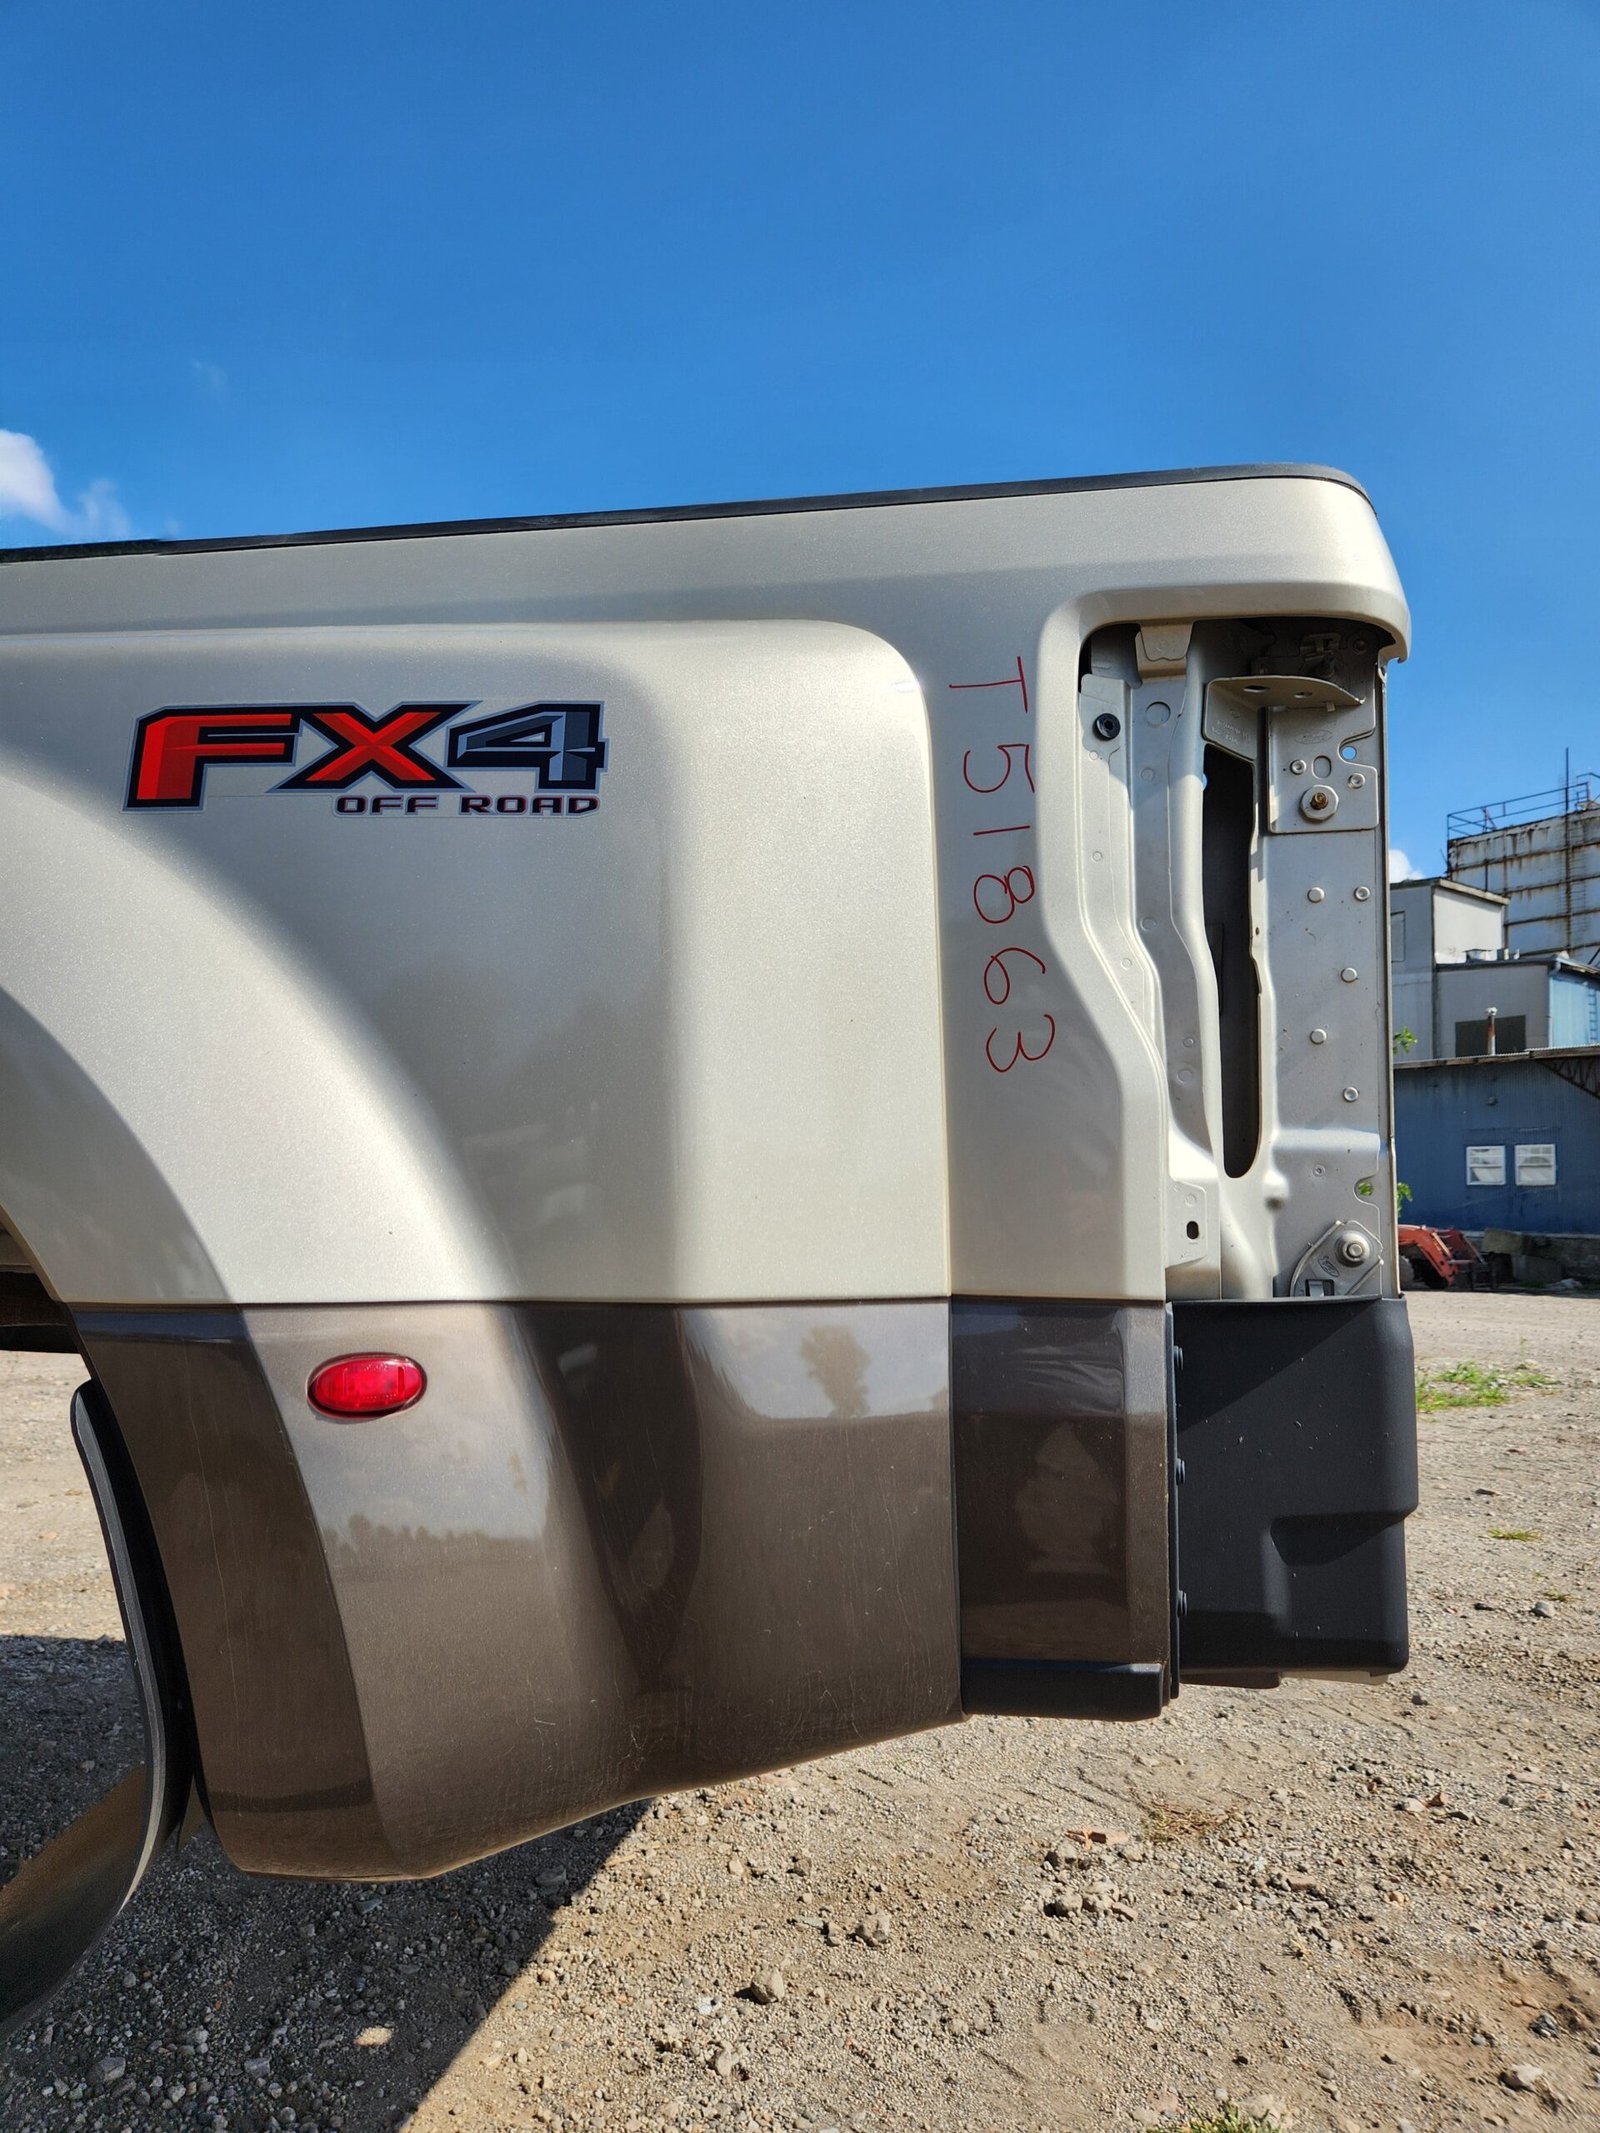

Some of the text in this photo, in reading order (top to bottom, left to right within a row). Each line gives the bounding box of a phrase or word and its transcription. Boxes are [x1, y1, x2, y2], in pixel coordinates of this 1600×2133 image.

[125, 702, 607, 810] FX4
[337, 796, 599, 814] OFF ROAD
